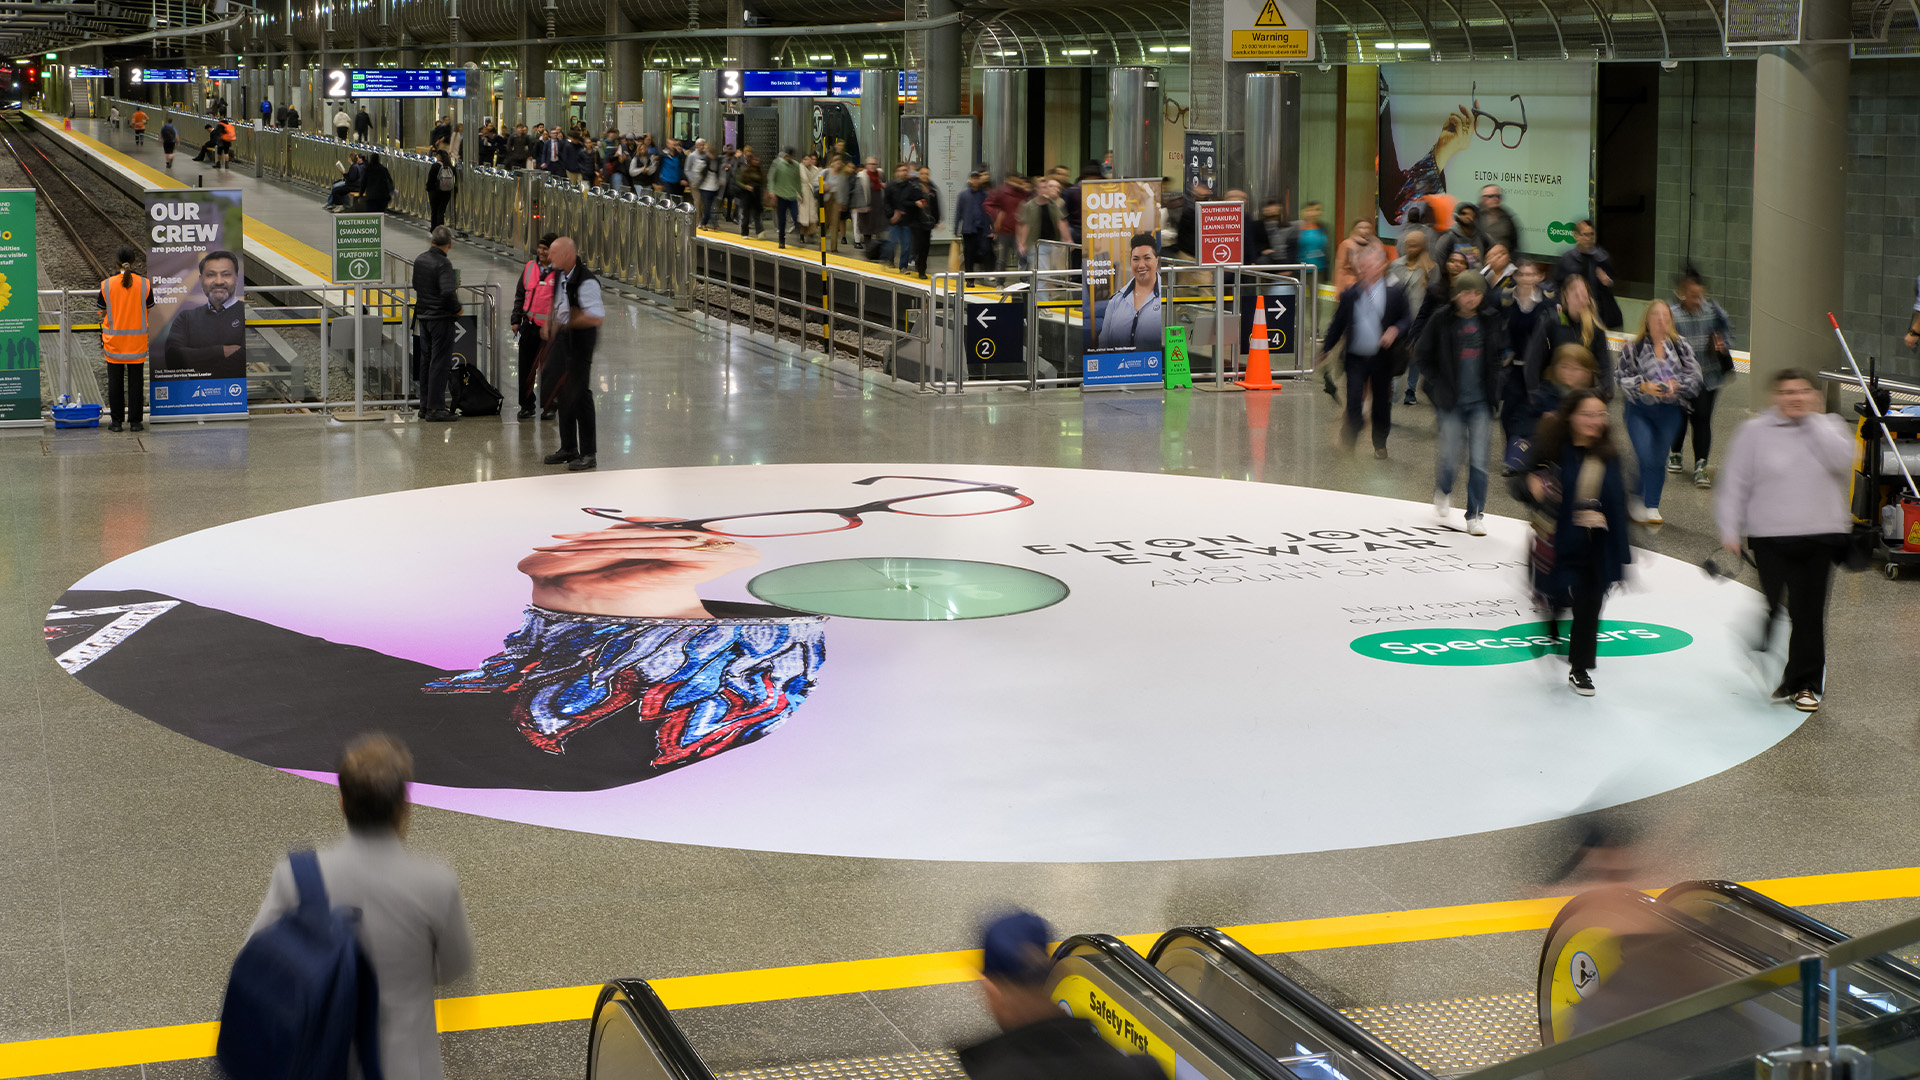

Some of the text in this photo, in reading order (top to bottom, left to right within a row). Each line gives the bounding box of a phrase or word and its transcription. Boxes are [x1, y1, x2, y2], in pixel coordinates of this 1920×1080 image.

[1252, 33, 1289, 43] Warning
[69, 68, 76, 78] 2
[131, 68, 142, 83] 2
[329, 71, 346, 96] 2
[724, 71, 739, 96] 3
[1474, 171, 1562, 185] ELTON JOHN EYEWEAR
[1086, 192, 1127, 210] OUR
[150, 202, 200, 221] OUR
[1086, 212, 1142, 230] CREW
[1204, 215, 1239, 223] (PAPAKURA)
[151, 224, 219, 243] CREW
[339, 227, 378, 236] (SWANSON)
[1098, 231, 1120, 239] people
[165, 245, 192, 254] people
[339, 251, 374, 259] PLATFORM
[1086, 259, 1112, 267] Please
[1086, 267, 1116, 277] respect
[152, 276, 182, 285] Please
[1086, 277, 1108, 285] them
[153, 285, 188, 295] respect
[981, 342, 990, 355] 2
[451, 356, 460, 370] 2
[1022, 524, 1469, 555] ELTON JOHN
[1102, 539, 1453, 565] EYEWEAR
[1163, 554, 1463, 576] JUST THE RIGHT
[1151, 560, 1530, 587] AMOUNT OF ELTON
[1342, 598, 1517, 614] New range
[1349, 609, 1521, 625] exclusively
[1089, 991, 1149, 1056] Safety First
